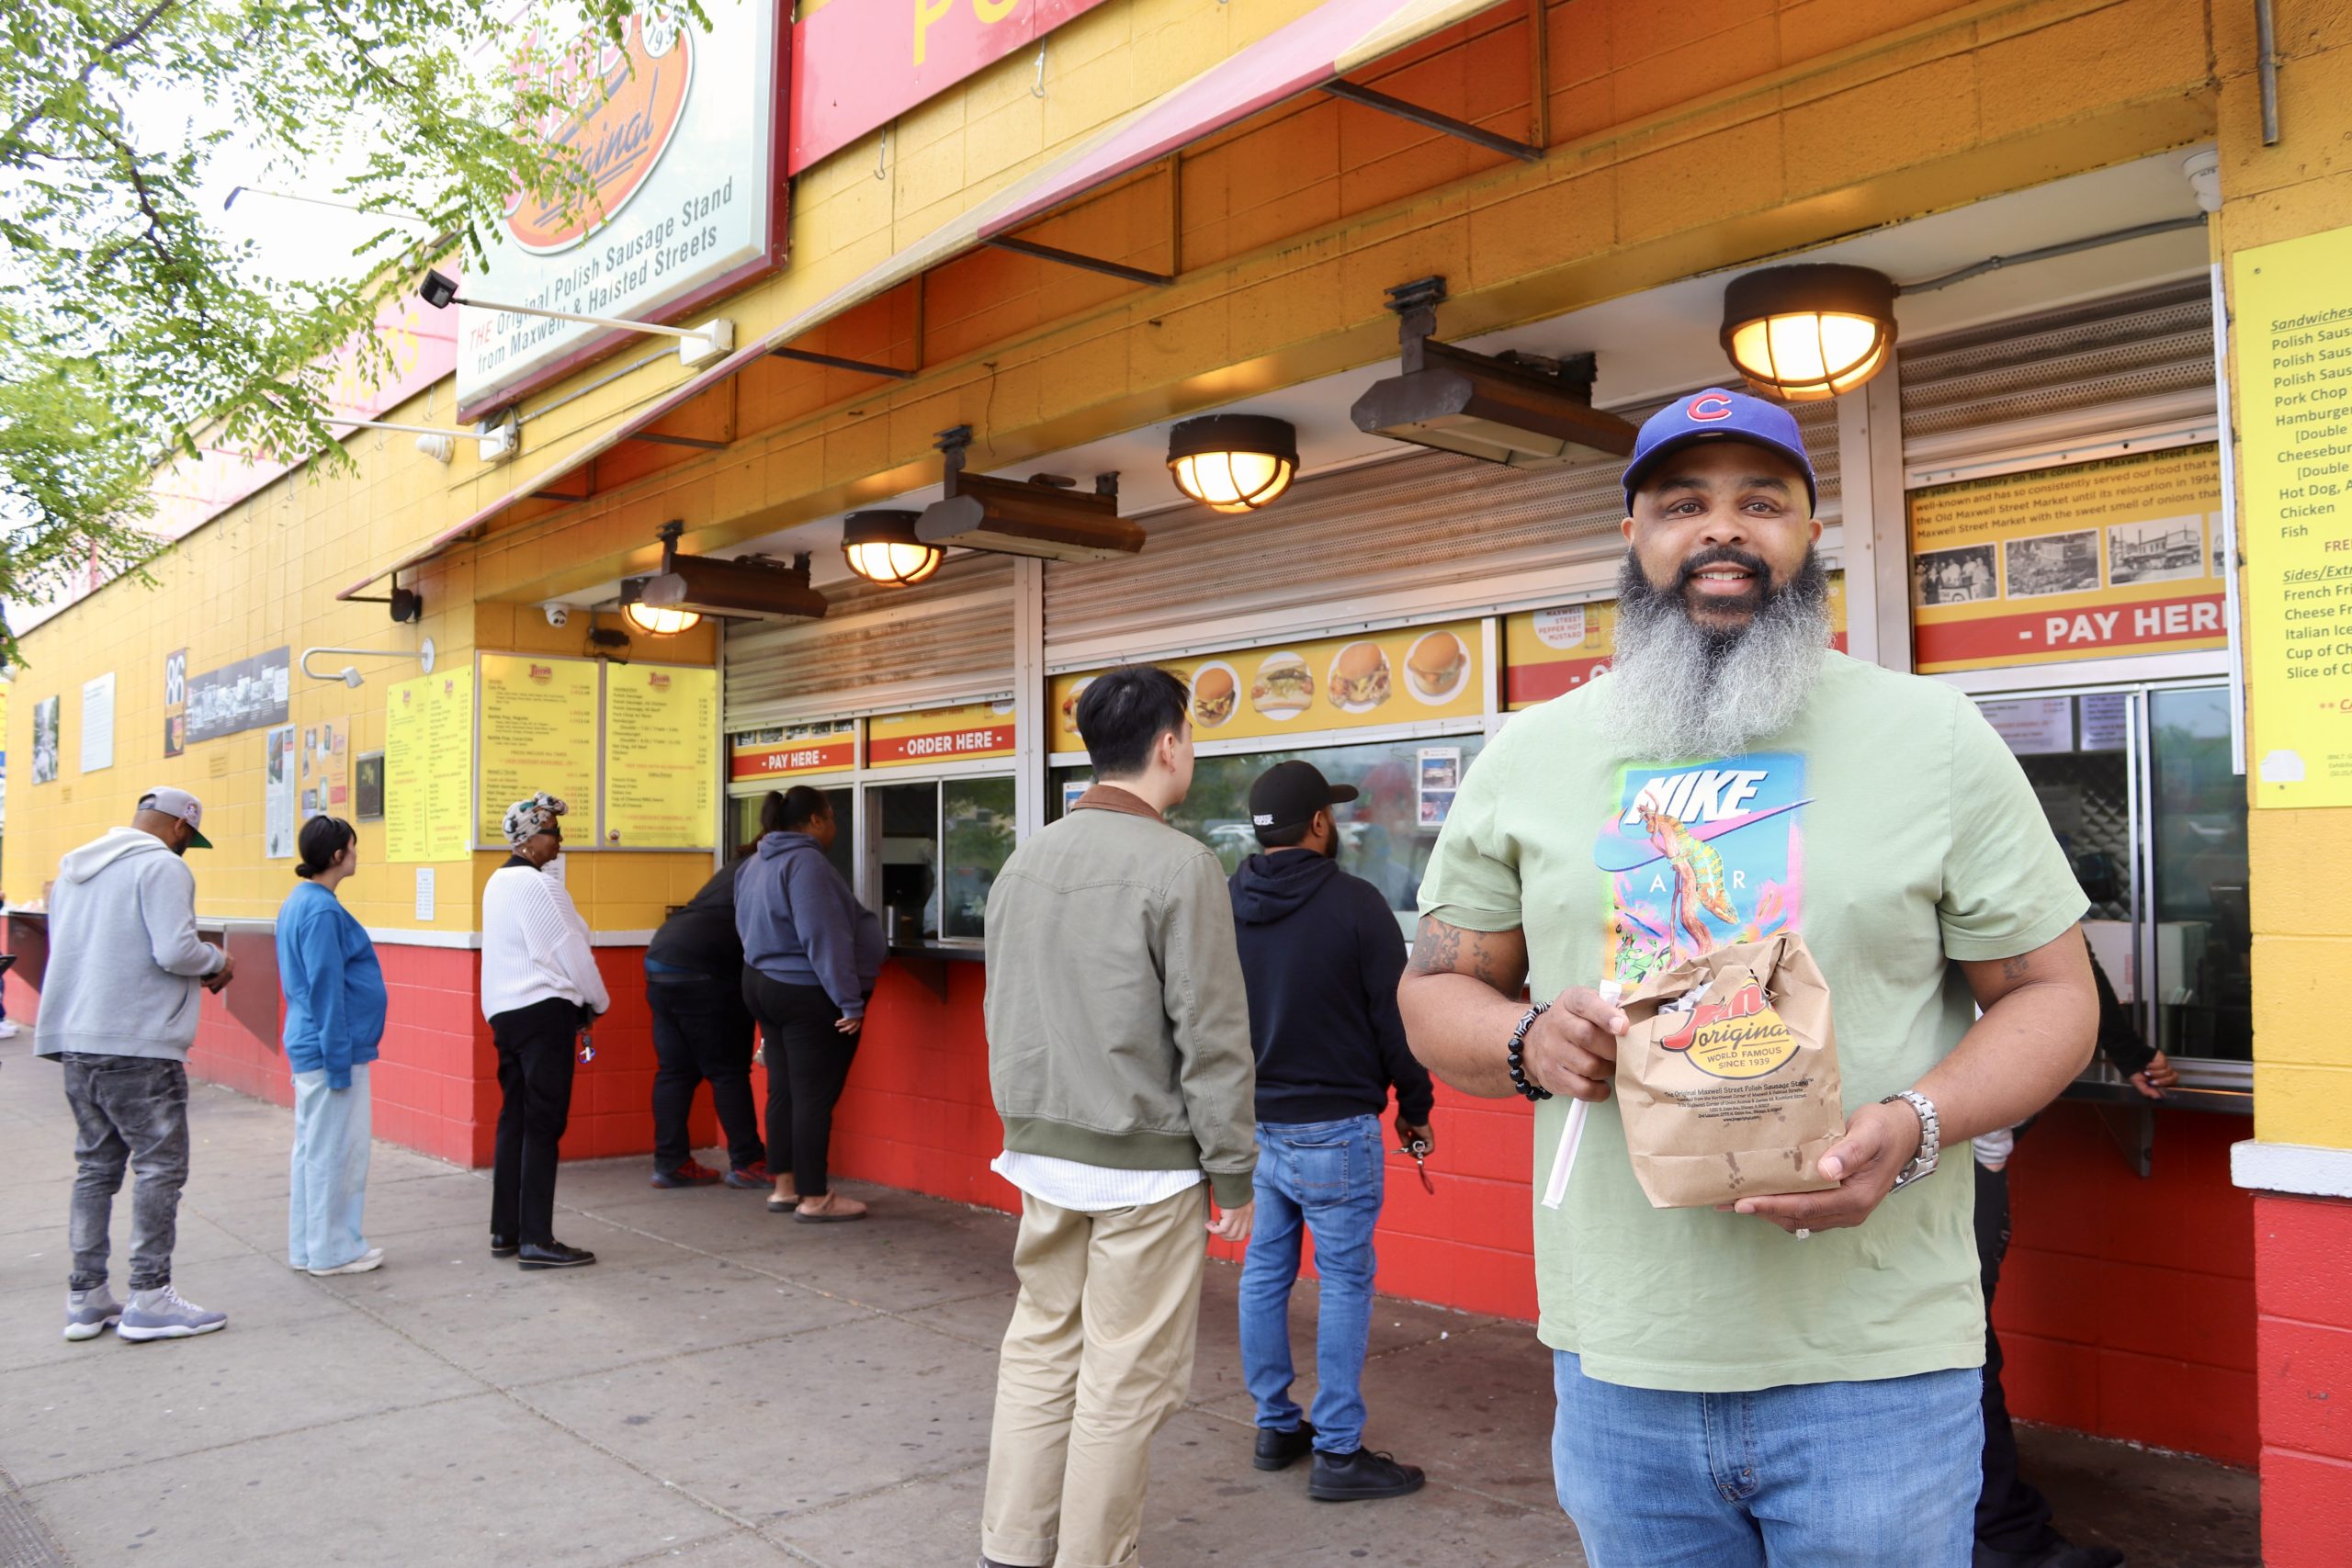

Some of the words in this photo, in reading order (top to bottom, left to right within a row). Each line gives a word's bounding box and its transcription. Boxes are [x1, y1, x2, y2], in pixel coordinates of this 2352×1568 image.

[469, 320, 493, 352] THE
[555, 258, 599, 302] Polish
[605, 217, 674, 273] Sausage
[682, 175, 733, 227] Stand
[477, 340, 505, 375] from
[573, 294, 582, 315] &
[654, 225, 717, 276] Streets
[2272, 333, 2313, 350] Polish
[2317, 327, 2352, 343] Saus
[2273, 352, 2314, 369] Polish
[2274, 371, 2315, 389] Polish
[2275, 392, 2307, 408] Pork
[2311, 387, 2347, 402] Chop
[1687, 393, 1732, 423] C
[2295, 424, 2347, 444] [Double
[1931, 485, 1957, 497] years
[1961, 481, 1971, 491] of
[1975, 476, 2009, 490] history
[2012, 475, 2026, 483] on
[2029, 470, 2047, 480] the
[2051, 465, 2085, 477] corner
[2088, 461, 2100, 471] of
[2104, 454, 2149, 468] Maxwell
[2154, 447, 2188, 460] Street
[2192, 444, 2214, 454] and
[2297, 462, 2349, 480] [Double
[1917, 496, 1972, 512] well-known
[1973, 492, 1992, 503] and
[1995, 490, 2011, 500] has
[2014, 488, 2026, 496] so
[2028, 477, 2092, 495] consistently
[2094, 472, 2131, 485] served
[2132, 470, 2152, 479] our
[2154, 462, 2181, 476] food
[2183, 459, 2207, 471] that
[2279, 488, 2304, 500] Hot
[2309, 483, 2341, 496] Dog,
[1917, 514, 1932, 525] the
[1935, 512, 1953, 523] Old
[1956, 506, 1996, 520] Maxwell
[1999, 502, 2030, 513] Street
[2033, 496, 2069, 508] Market
[2072, 491, 2097, 502] until
[2099, 488, 2113, 499] its
[2116, 479, 2173, 496] relocation
[2176, 477, 2187, 488] in
[1917, 525, 1956, 539] Maxwell
[1959, 521, 1989, 533] Street
[1992, 515, 2027, 528] Market
[2030, 512, 2052, 524] with
[2055, 508, 2073, 520] the
[2075, 504, 2107, 516] sweet
[2110, 499, 2139, 512] smell
[2142, 497, 2154, 507] of
[2156, 492, 2195, 505] onions
[2198, 488, 2222, 501] that
[2280, 503, 2335, 519] Chicken
[2281, 525, 2309, 538] Fish
[2324, 538, 2352, 553] FRE
[2284, 586, 2331, 602] French
[1545, 606, 1581, 616] MAXWELL
[1555, 615, 1581, 625] STREET
[2285, 606, 2335, 621] Cheese
[1538, 625, 1565, 635] PEPPER
[2046, 611, 2121, 645] PAY
[2134, 599, 2227, 637] HER
[1548, 631, 1582, 641] MUSTARD
[2286, 626, 2330, 640] Italian
[2287, 647, 2312, 660] Cup
[2317, 644, 2332, 657] of
[165, 654, 185, 707] 86
[2287, 665, 2319, 680] Slice
[2323, 664, 2337, 677] of
[907, 736, 953, 756] ORDER
[956, 730, 993, 750] HERE
[768, 753, 788, 770] PAY
[791, 750, 820, 767] HERE
[1623, 770, 1769, 825] NIKE
[1707, 1052, 1737, 1064] WORLD
[1742, 1046, 1782, 1058] FAMOUS
[1718, 1060, 1746, 1069] SINCE
[1749, 1057, 1770, 1066] 1939
[1675, 1090, 1696, 1099] Original
[1698, 1088, 1722, 1096] Maxwell
[1745, 1084, 1762, 1092] Polish
[1764, 1082, 1789, 1090] Sausage
